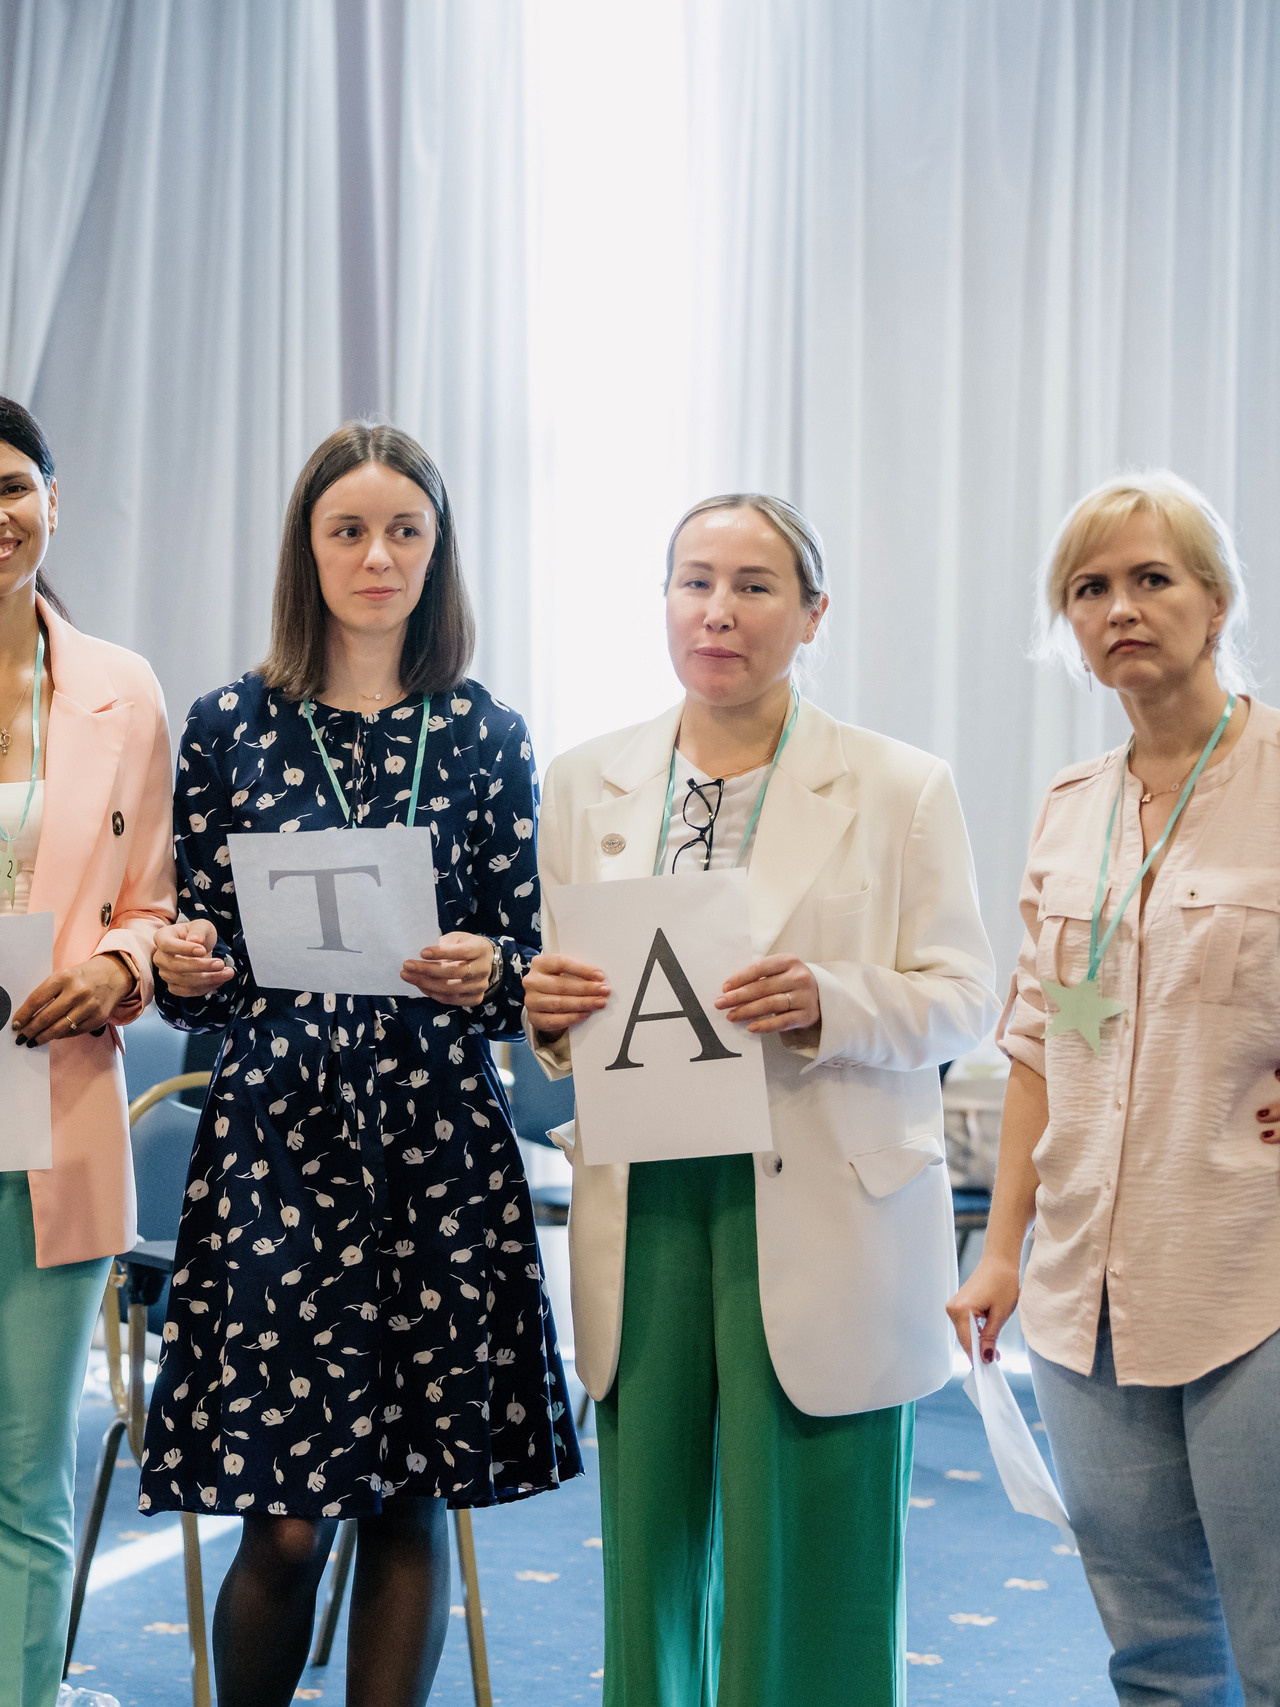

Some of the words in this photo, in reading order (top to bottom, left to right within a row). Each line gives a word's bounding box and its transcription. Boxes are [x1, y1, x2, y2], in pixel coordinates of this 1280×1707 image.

[6, 859, 14, 879] 2
[268, 864, 382, 954] Т
[604, 927, 743, 1071] А
